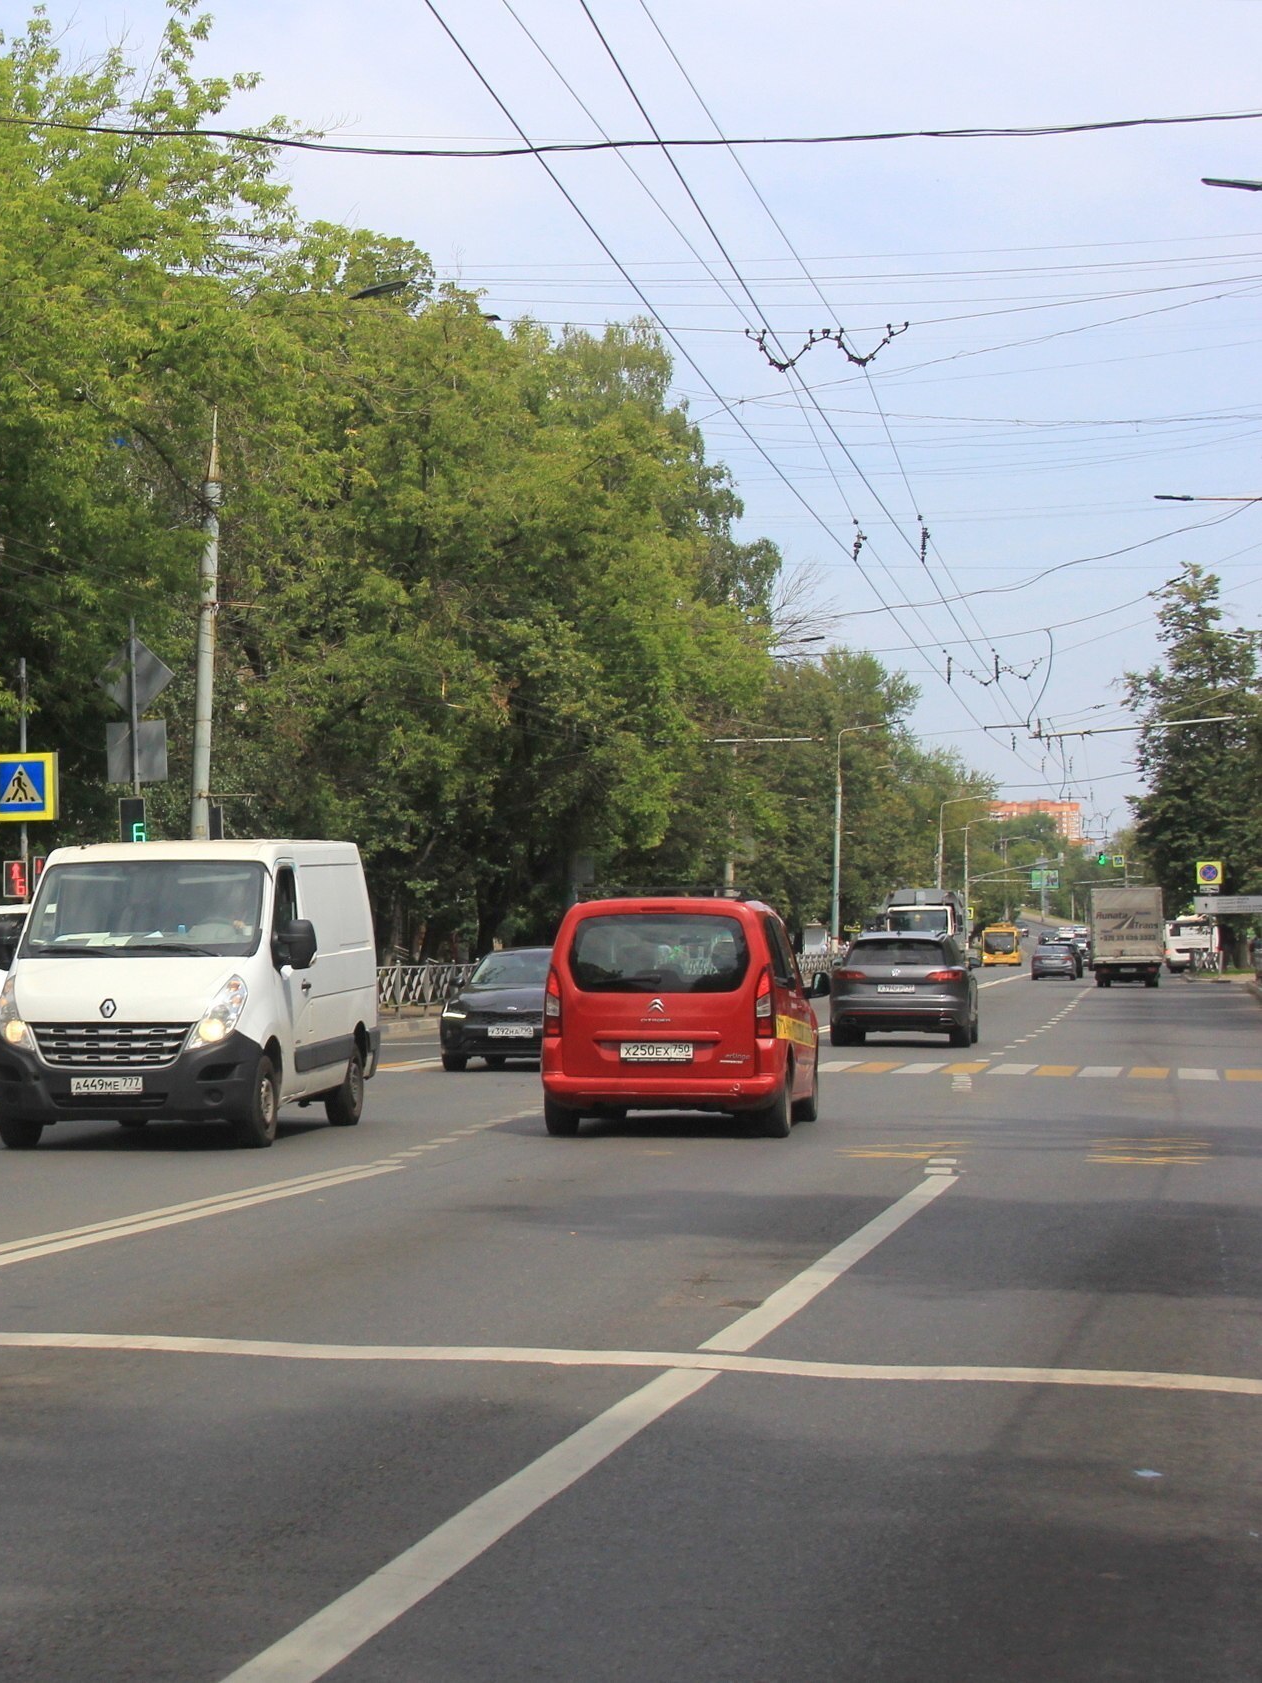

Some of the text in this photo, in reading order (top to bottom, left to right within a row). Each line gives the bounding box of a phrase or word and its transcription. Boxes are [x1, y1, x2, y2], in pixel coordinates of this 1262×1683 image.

[133, 823, 146, 842] 6
[17, 879, 26, 895] 6
[624, 1044, 690, 1056] Х250ЕХ 750
[75, 1077, 140, 1091] А449МЕ 777
